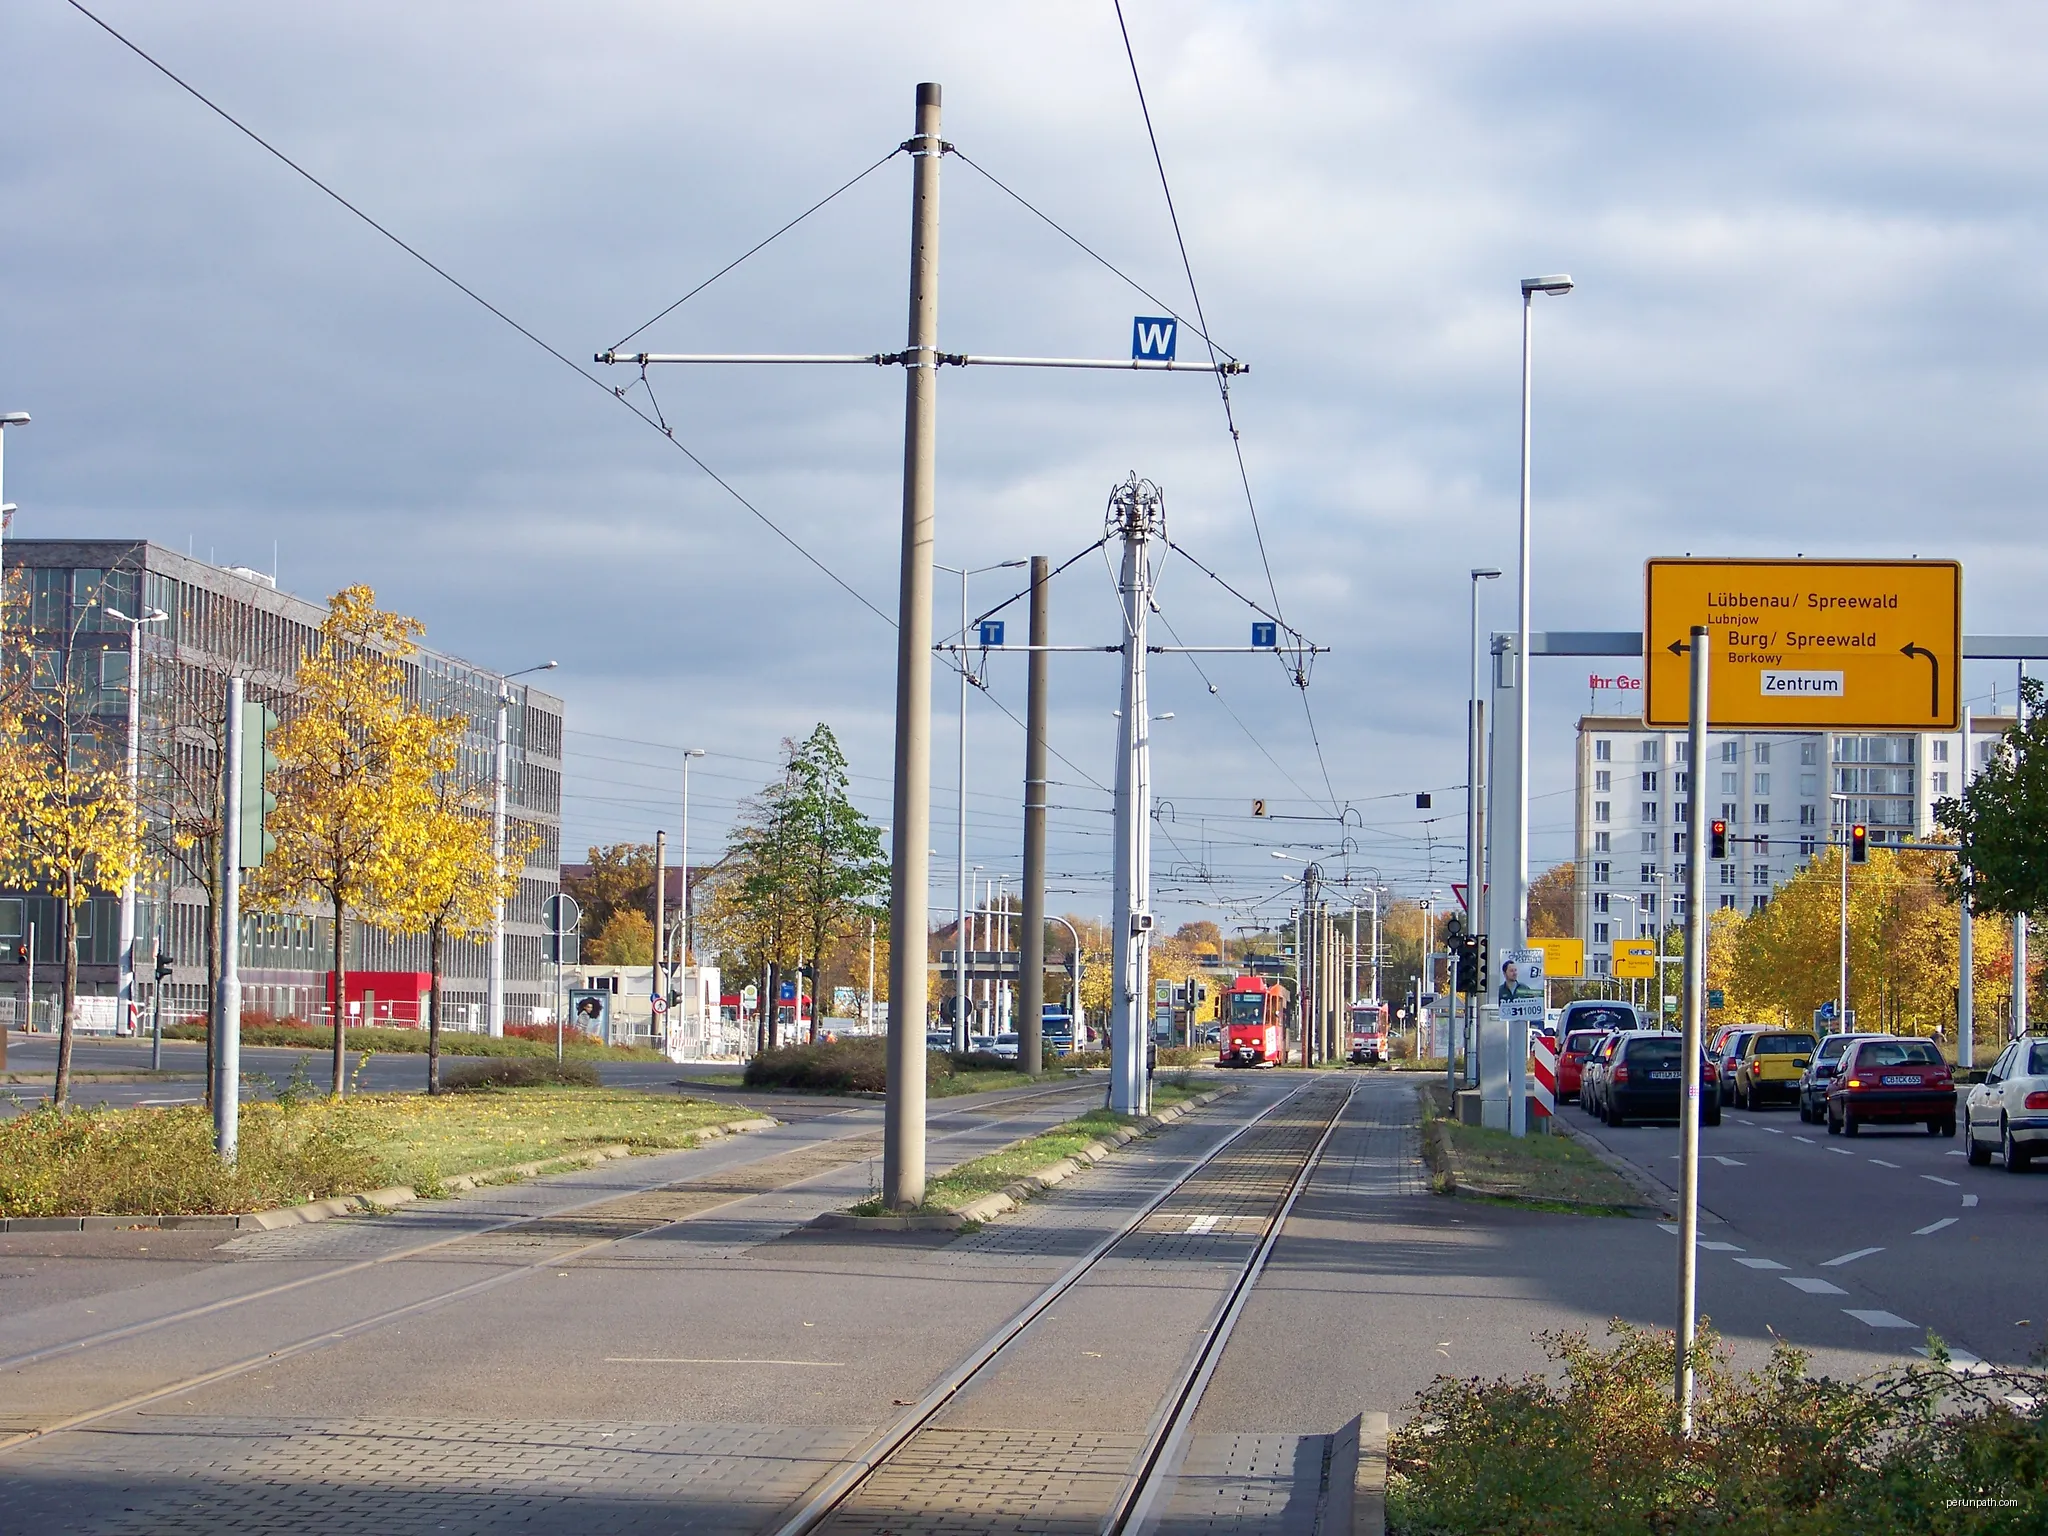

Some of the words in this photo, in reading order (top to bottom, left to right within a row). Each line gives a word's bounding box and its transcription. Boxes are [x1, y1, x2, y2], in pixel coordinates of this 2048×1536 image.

[1137, 322, 1174, 355] W
[1707, 592, 1799, 608] Lübbenau/
[1807, 593, 1898, 612] Spreewald
[1707, 613, 1760, 627] Lubnjow
[985, 624, 999, 642] T
[1257, 625, 1270, 643] T
[1728, 631, 1778, 650] Burg/
[1786, 632, 1876, 650] Spreewald
[1728, 652, 1783, 666] Borkowy
[1766, 675, 1839, 691] Zentrum
[1254, 800, 1263, 815] 2
